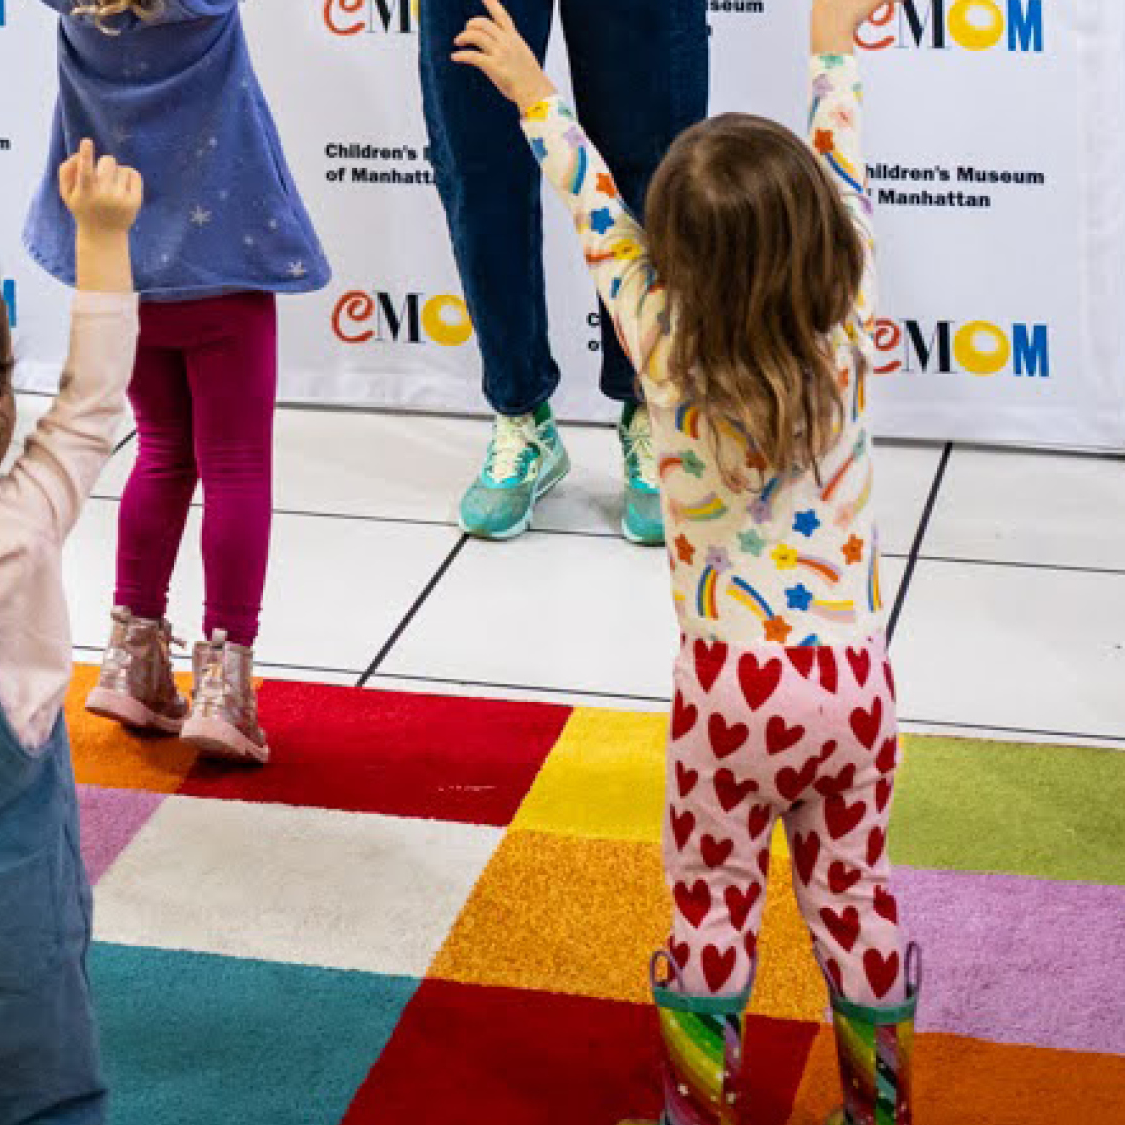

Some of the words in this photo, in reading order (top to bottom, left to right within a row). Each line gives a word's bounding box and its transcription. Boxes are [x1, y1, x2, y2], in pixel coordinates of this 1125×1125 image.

[708, 0, 764, 13] seum
[326, 143, 418, 160] Children's
[326, 168, 345, 181] of
[350, 167, 436, 185] Manhatt
[866, 165, 951, 182] hildren's
[957, 168, 1044, 183] Museum
[878, 189, 990, 206] Manhattan
[331, 290, 472, 346] CMO
